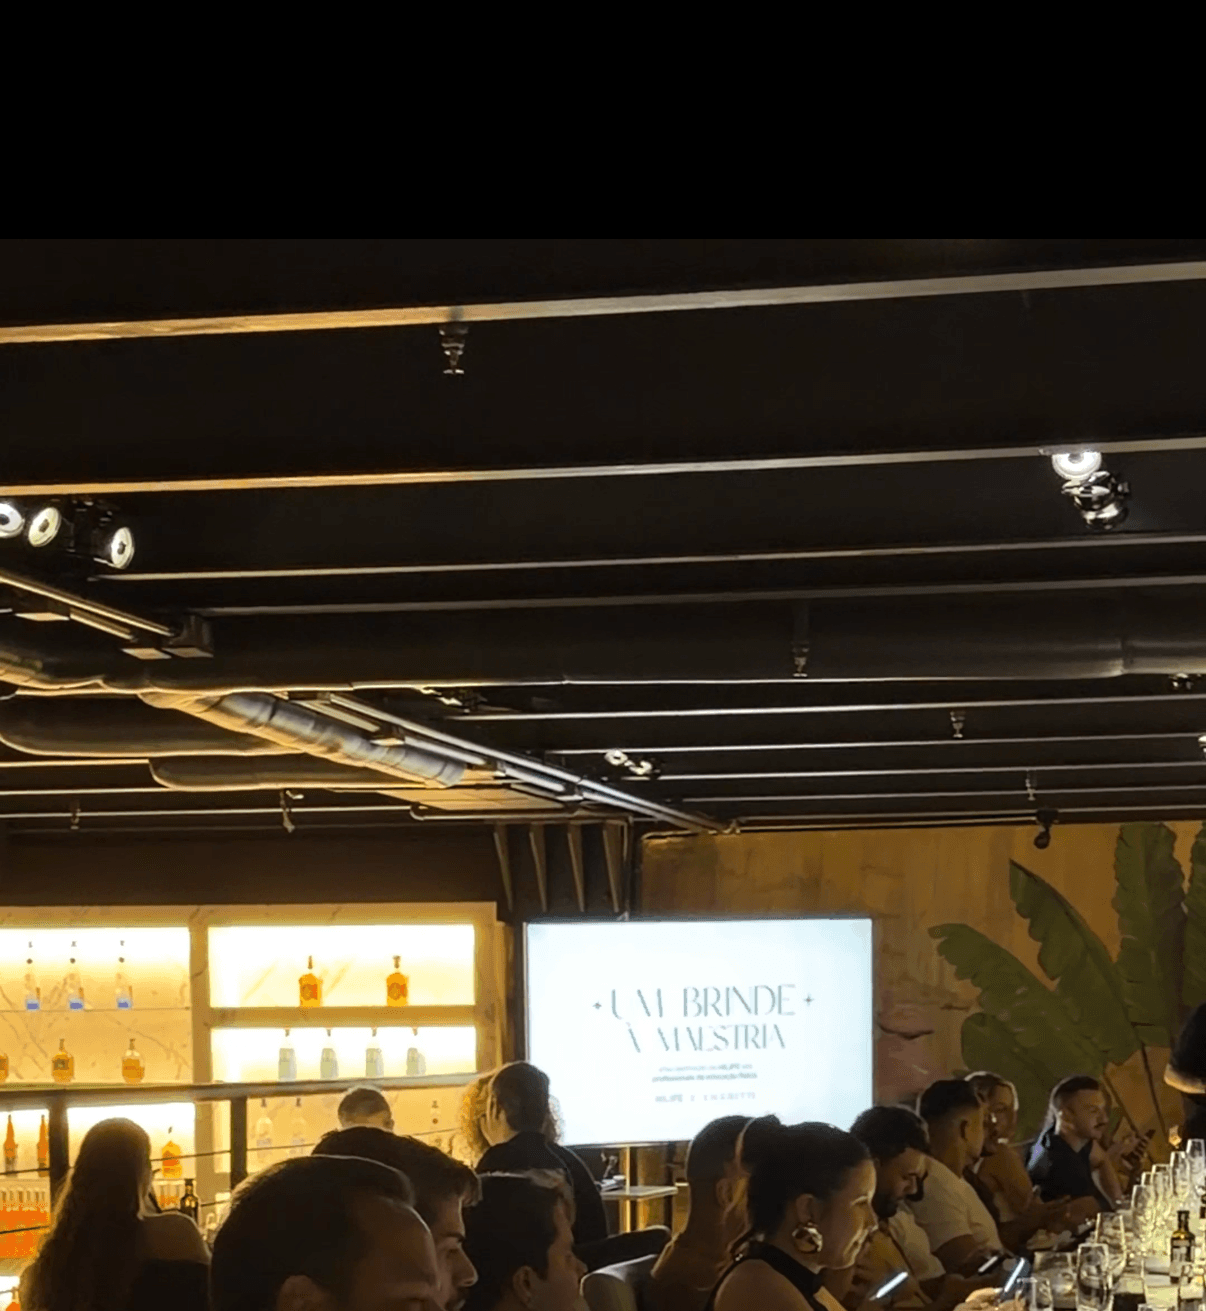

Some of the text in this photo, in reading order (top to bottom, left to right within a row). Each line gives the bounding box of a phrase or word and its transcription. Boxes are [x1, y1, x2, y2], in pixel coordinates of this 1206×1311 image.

[611, 984, 796, 1020] UM BRINDE
[656, 1023, 786, 1052] MAESTRIA
